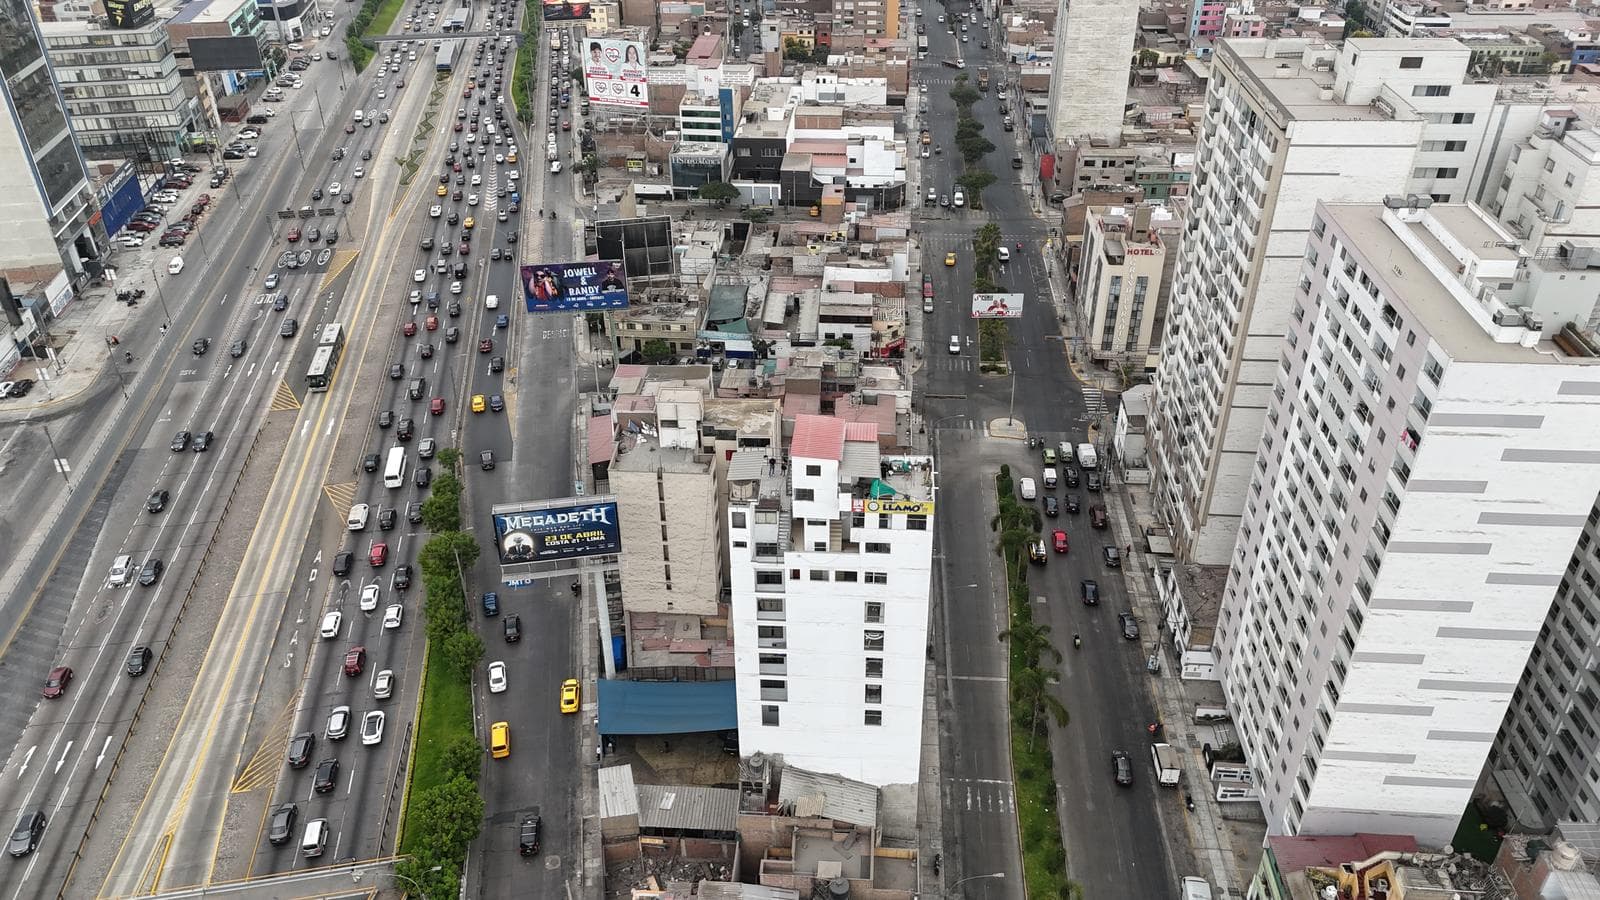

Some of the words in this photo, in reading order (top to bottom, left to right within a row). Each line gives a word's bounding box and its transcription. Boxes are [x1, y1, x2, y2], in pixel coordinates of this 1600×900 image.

[630, 85, 640, 97] 4
[1127, 248, 1154, 256] HOTEL
[563, 267, 597, 278] JOWELL
[580, 276, 588, 286] &
[568, 286, 600, 296] RANDY
[499, 506, 612, 536] MEGADETH
[576, 530, 605, 538] ABRIL
[284, 549, 322, 668] SALIDA
